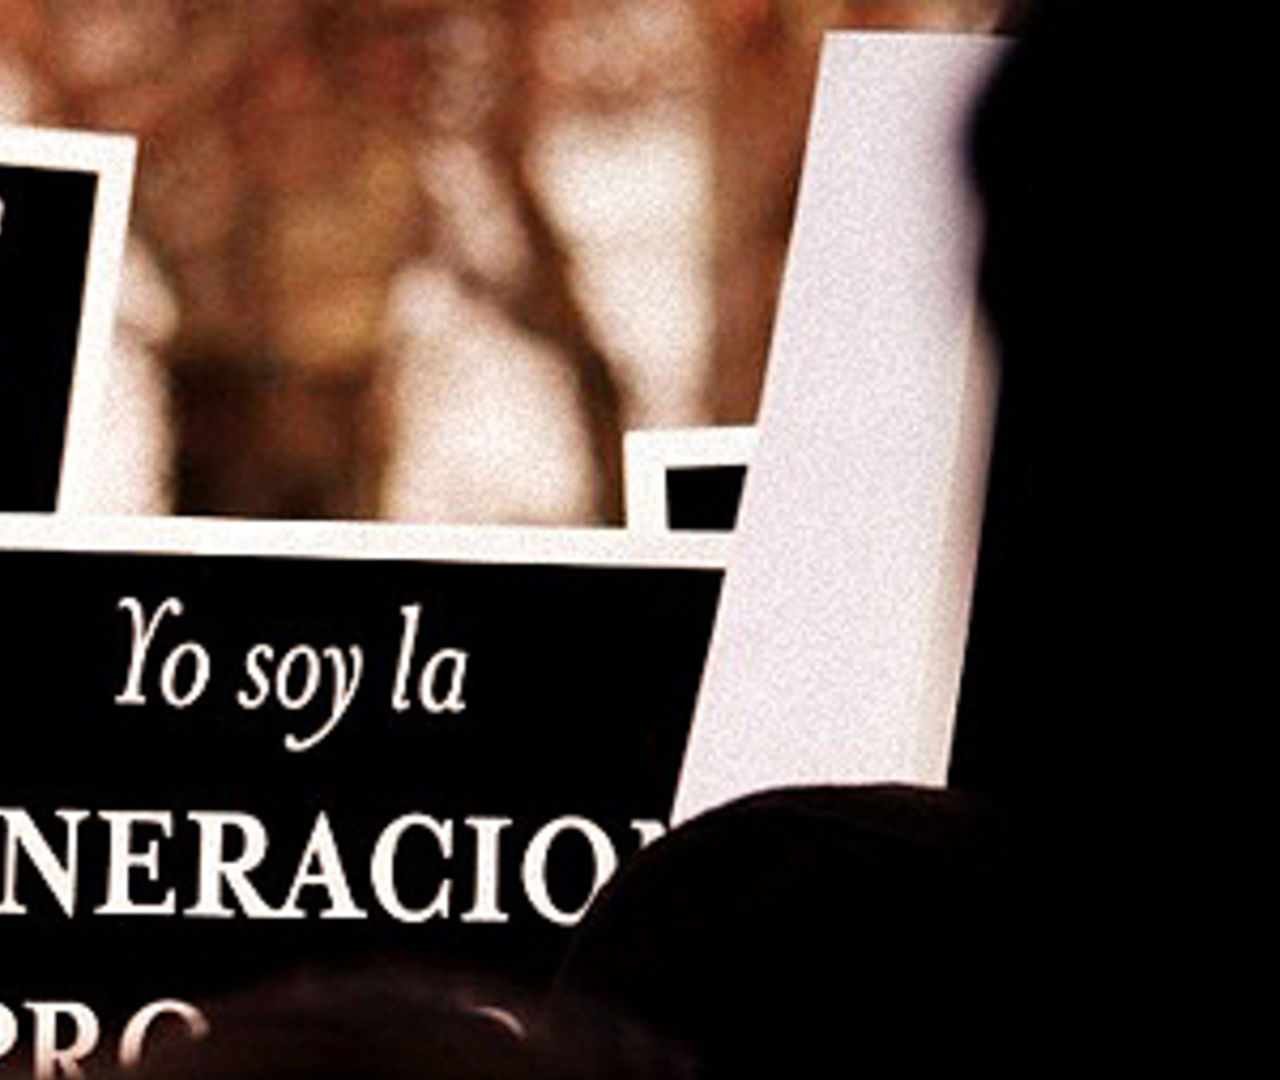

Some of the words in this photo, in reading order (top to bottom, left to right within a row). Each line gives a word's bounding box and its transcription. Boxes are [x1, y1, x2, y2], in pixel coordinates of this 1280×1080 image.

[113, 596, 210, 708] Yo
[236, 643, 364, 752] soy
[390, 604, 468, 714] la
